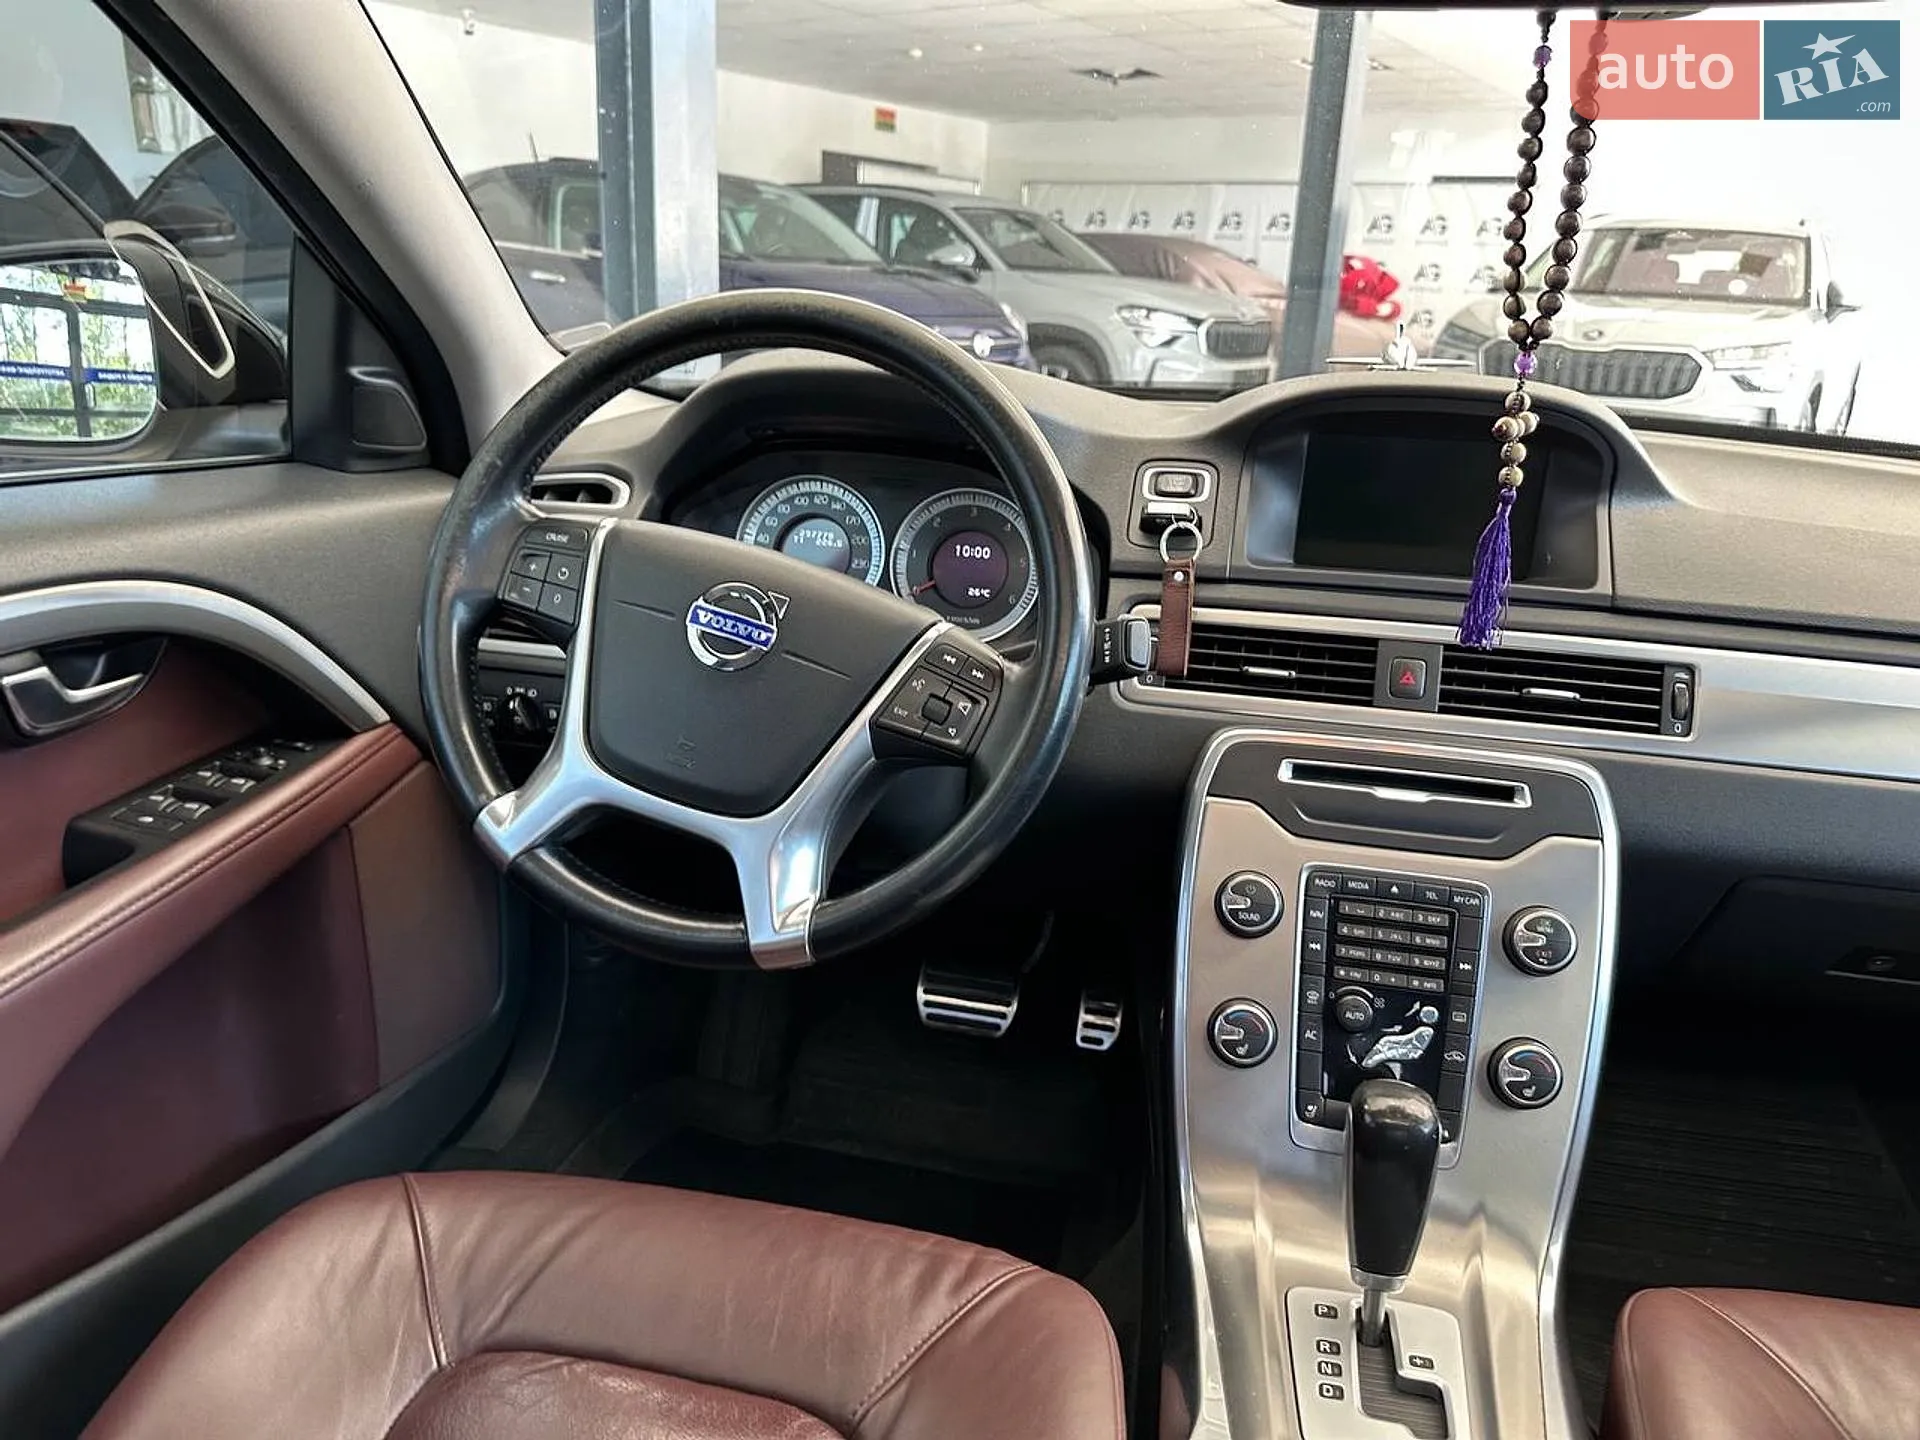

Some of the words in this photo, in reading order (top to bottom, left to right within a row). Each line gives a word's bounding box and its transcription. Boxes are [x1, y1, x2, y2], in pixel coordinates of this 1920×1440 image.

[955, 544, 991, 559] 10:00
[696, 608, 769, 642] VOLVO
[1315, 878, 1336, 888] RADIO
[1348, 881, 1369, 890] MEDIA
[1345, 1011, 1365, 1020] AUTO
[1305, 1029, 1317, 1040] AC
[1318, 1306, 1328, 1315] P
[1319, 1342, 1330, 1352] R
[1321, 1363, 1332, 1373] N
[1322, 1386, 1333, 1396] D
